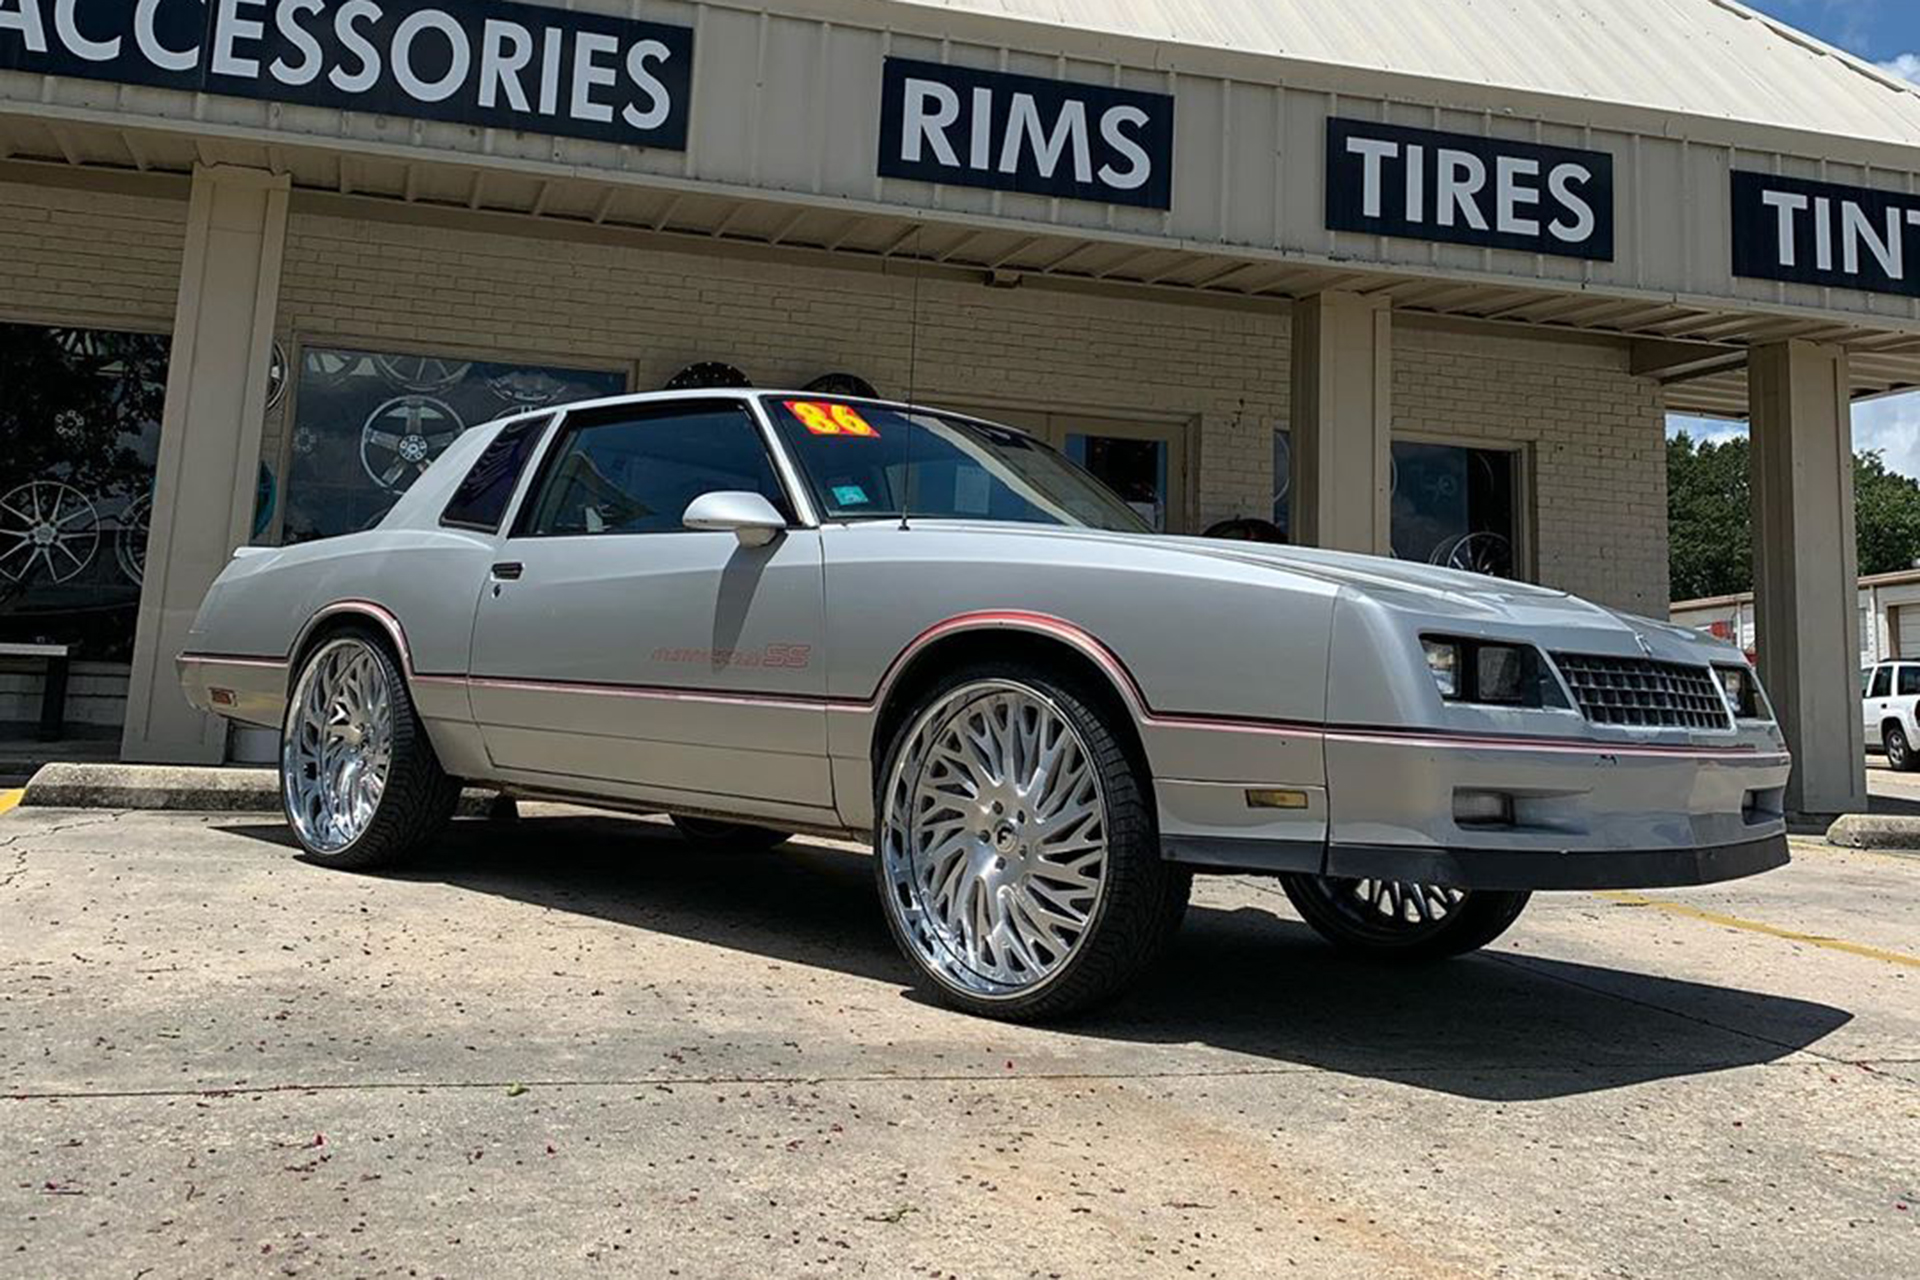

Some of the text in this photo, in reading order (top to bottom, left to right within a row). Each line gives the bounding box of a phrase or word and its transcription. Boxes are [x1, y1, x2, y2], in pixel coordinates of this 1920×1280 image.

[901, 77, 1151, 190] RIMS
[1346, 136, 1595, 243] TIRES
[1762, 189, 1920, 280] TIN
[793, 401, 870, 436] 86
[763, 643, 811, 668] SS
